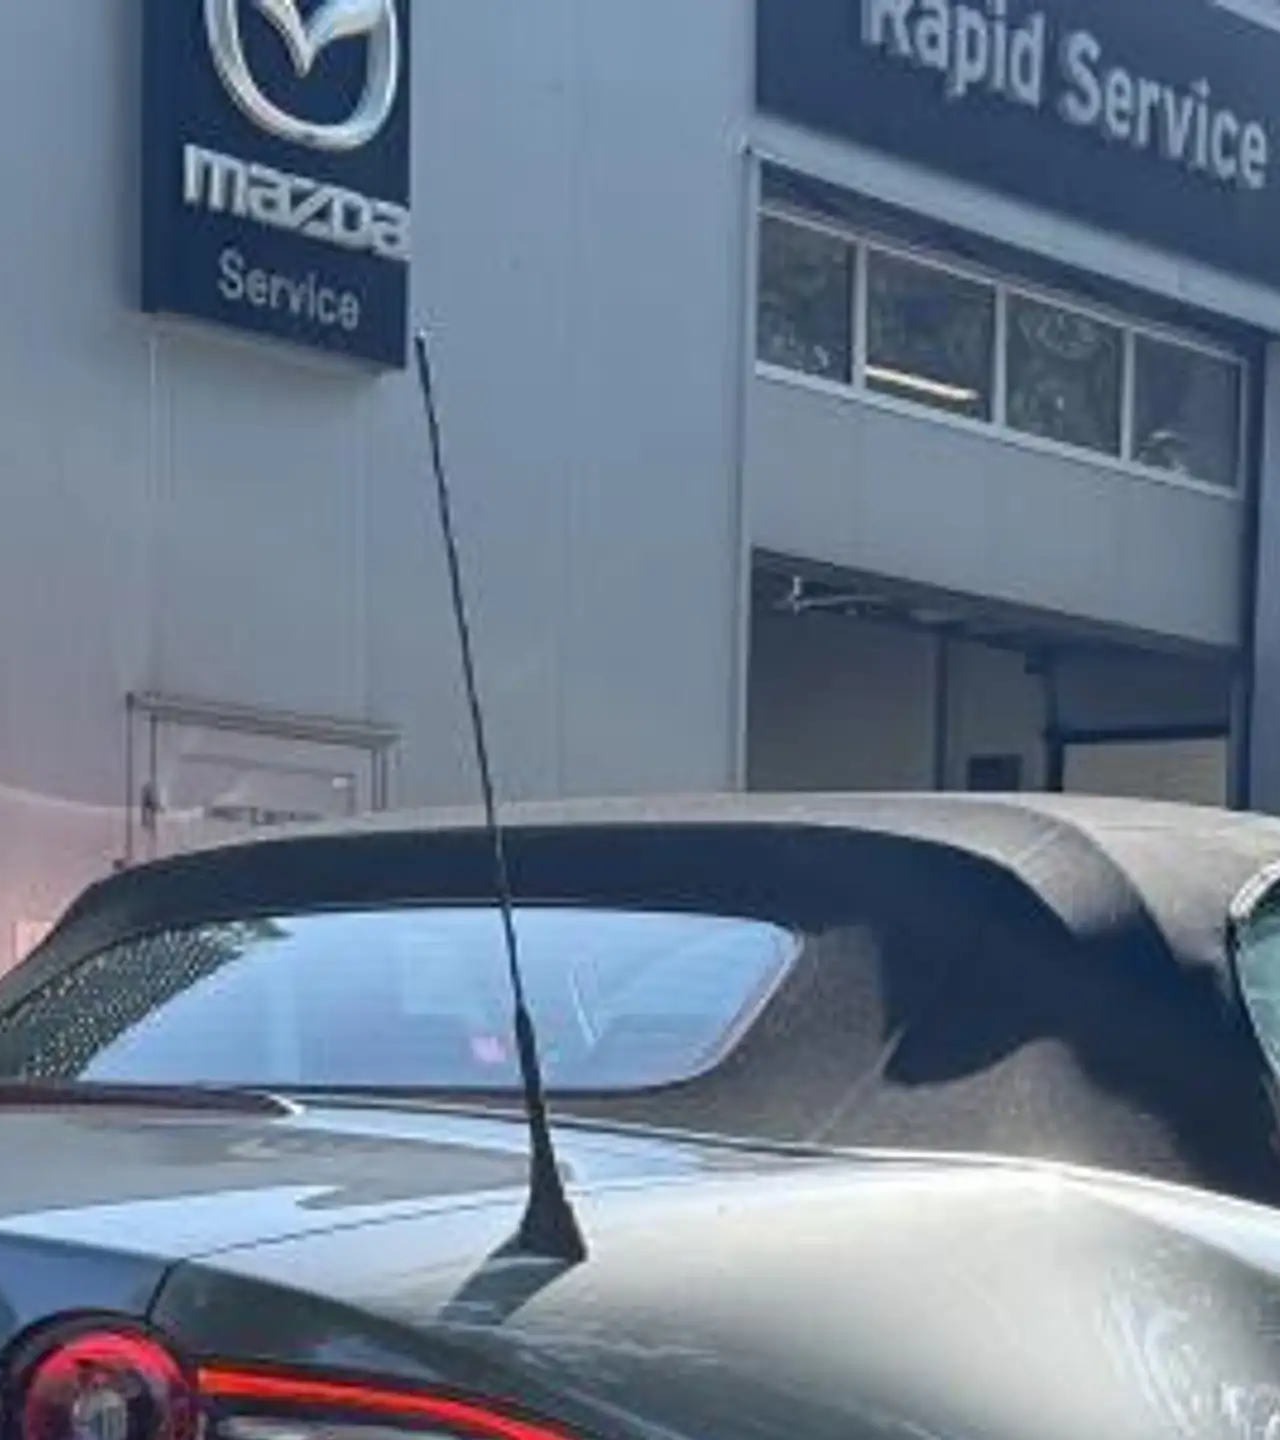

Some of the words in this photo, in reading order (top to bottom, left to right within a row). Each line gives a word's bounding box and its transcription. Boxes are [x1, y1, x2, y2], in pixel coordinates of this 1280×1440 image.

[1058, 29, 1267, 189] Service
[183, 143, 412, 262] mazda
[218, 247, 360, 331] Service
